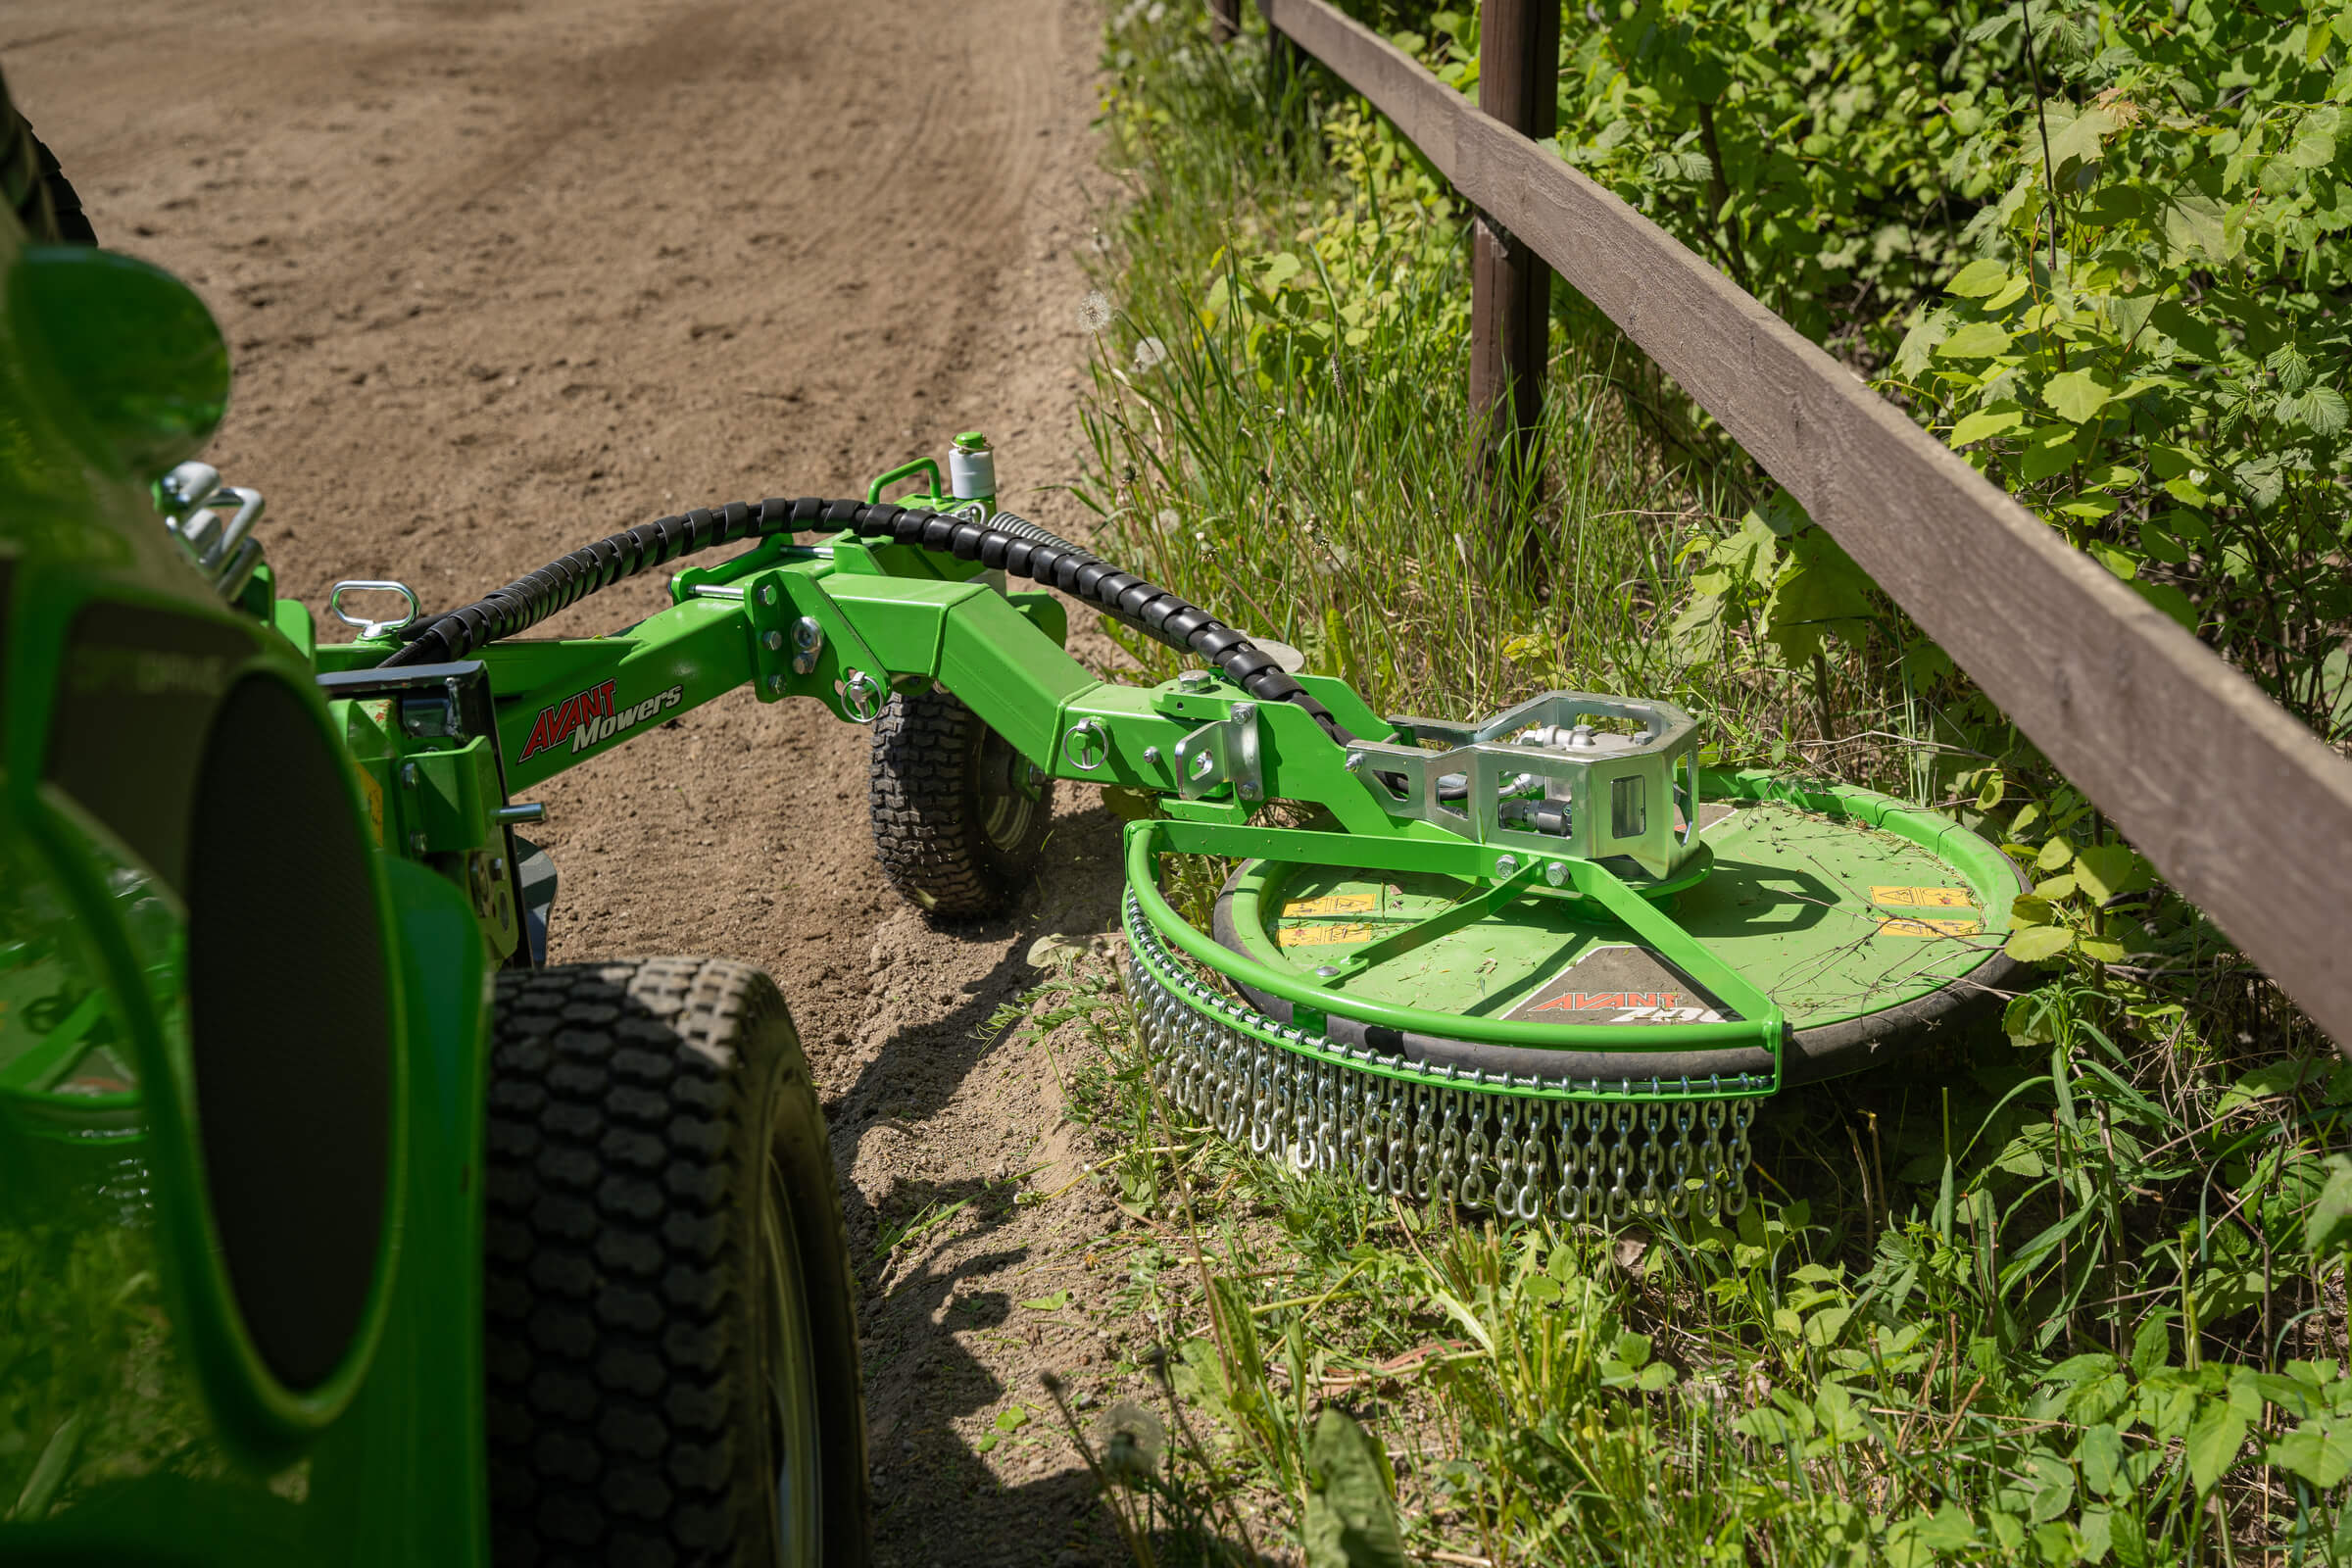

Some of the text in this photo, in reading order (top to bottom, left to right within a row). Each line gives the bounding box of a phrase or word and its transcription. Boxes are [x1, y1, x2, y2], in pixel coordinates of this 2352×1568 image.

[517, 678, 616, 763] AVANT
[571, 685, 683, 754] Mowers
[1528, 993, 1683, 1011] AVANT
